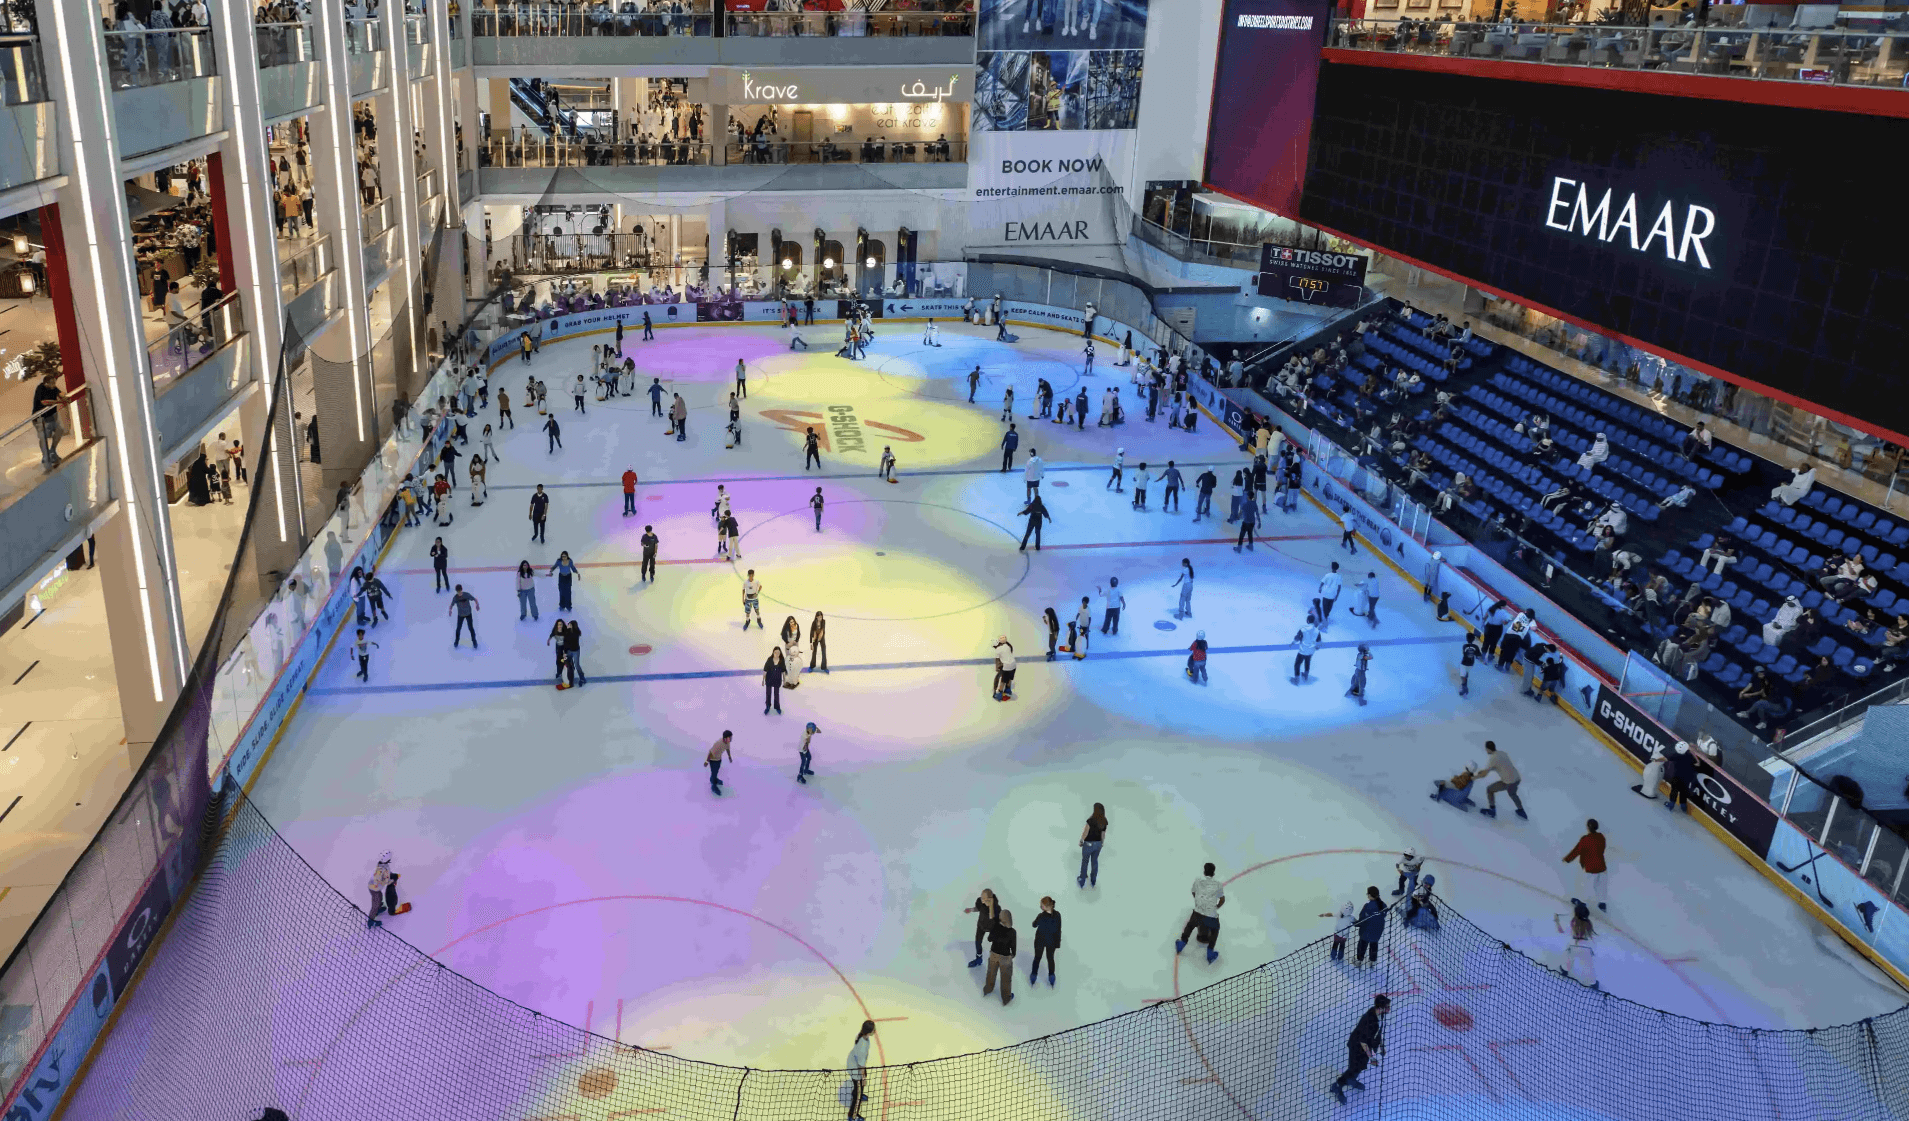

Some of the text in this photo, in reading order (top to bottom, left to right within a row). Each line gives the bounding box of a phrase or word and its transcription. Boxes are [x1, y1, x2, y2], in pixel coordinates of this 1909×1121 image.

[743, 73, 798, 99] Krave
[876, 116, 898, 128] eat
[1001, 158, 1103, 174] BOOK NOW
[975, 185, 1124, 197] entertainment.emaar.com
[1004, 220, 1090, 242] EMAAR
[1545, 176, 1716, 270] EMAAR
[1293, 249, 1359, 270] TISSOT
[564, 313, 630, 328] GRAB YOUR HELMET
[1028, 309, 1046, 317] CALM
[1060, 314, 1080, 323] SKATE
[827, 405, 867, 454] G-SHOCK
[1600, 699, 1666, 756] G-SHOCK
[1688, 782, 1738, 824] AKLEY
